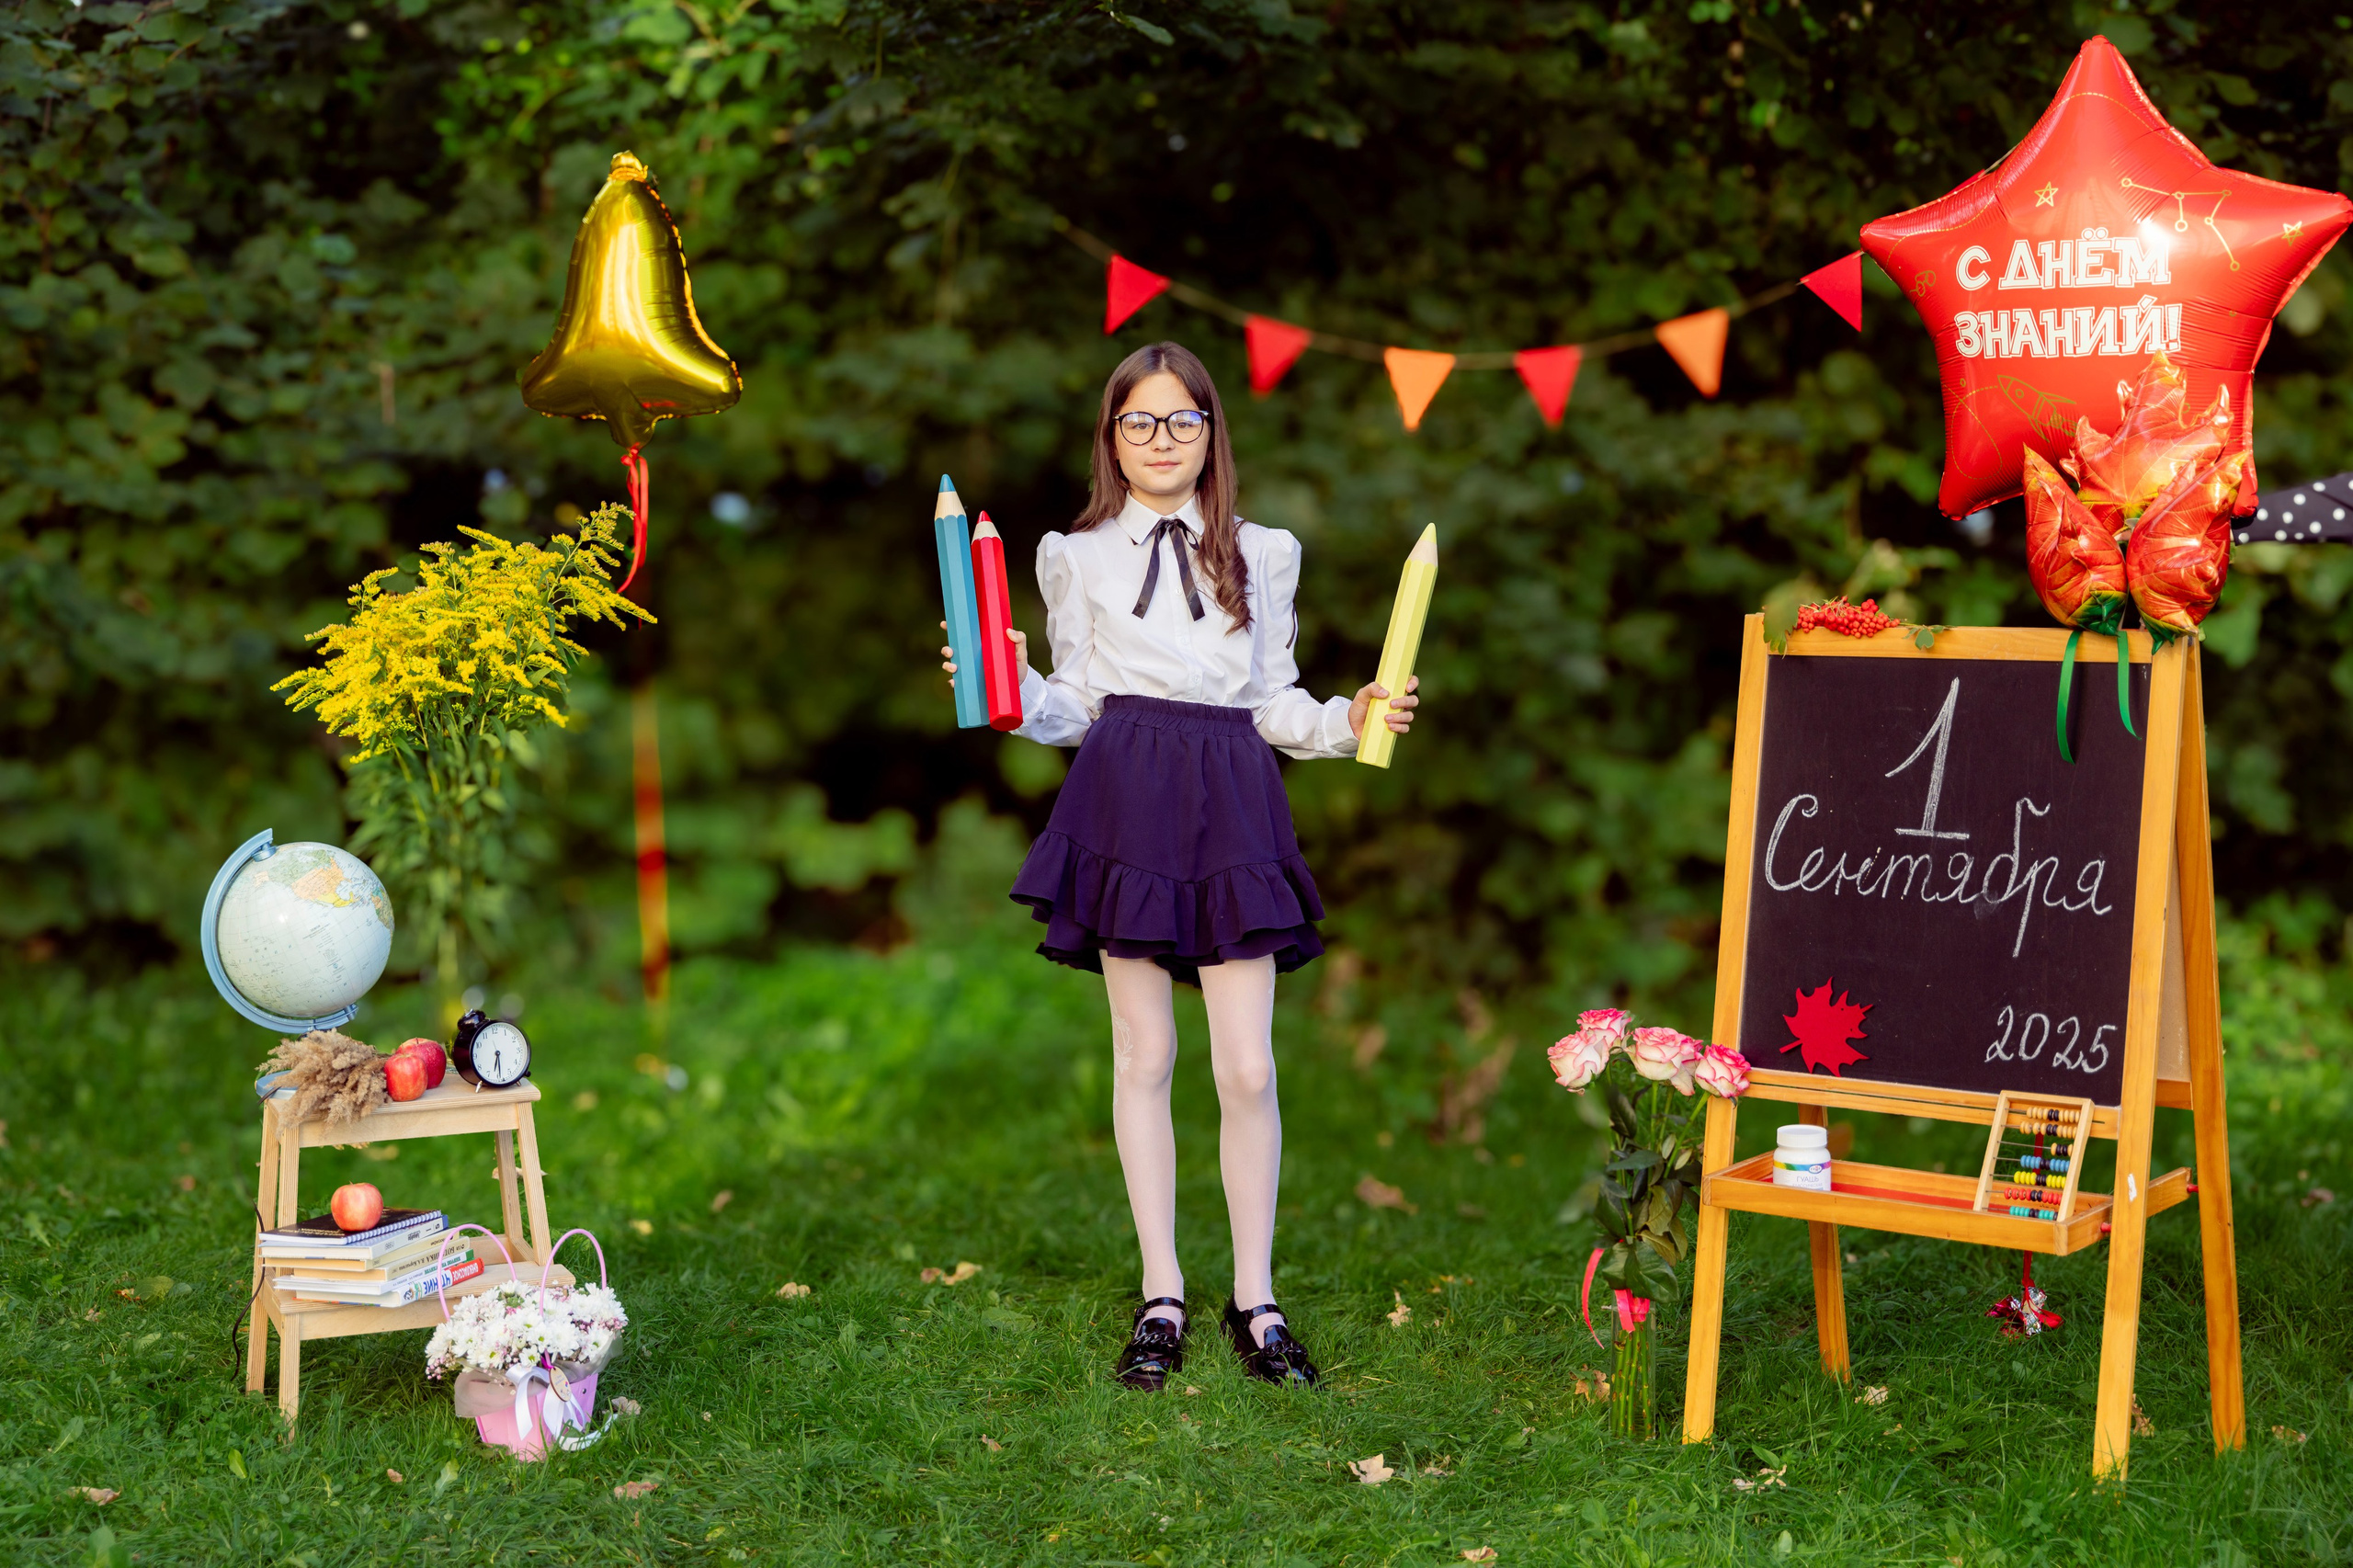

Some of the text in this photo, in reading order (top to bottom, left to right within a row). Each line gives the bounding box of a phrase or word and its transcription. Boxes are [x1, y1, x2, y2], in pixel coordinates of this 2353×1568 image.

[1955, 227, 2172, 291] С ДНЁМ
[1954, 293, 2183, 358] ЗНАНИЙ!
[1884, 676, 1970, 840] 1
[1984, 1005, 2118, 1074] 2025
[423, 1273, 450, 1294] ЧТНИЕ
